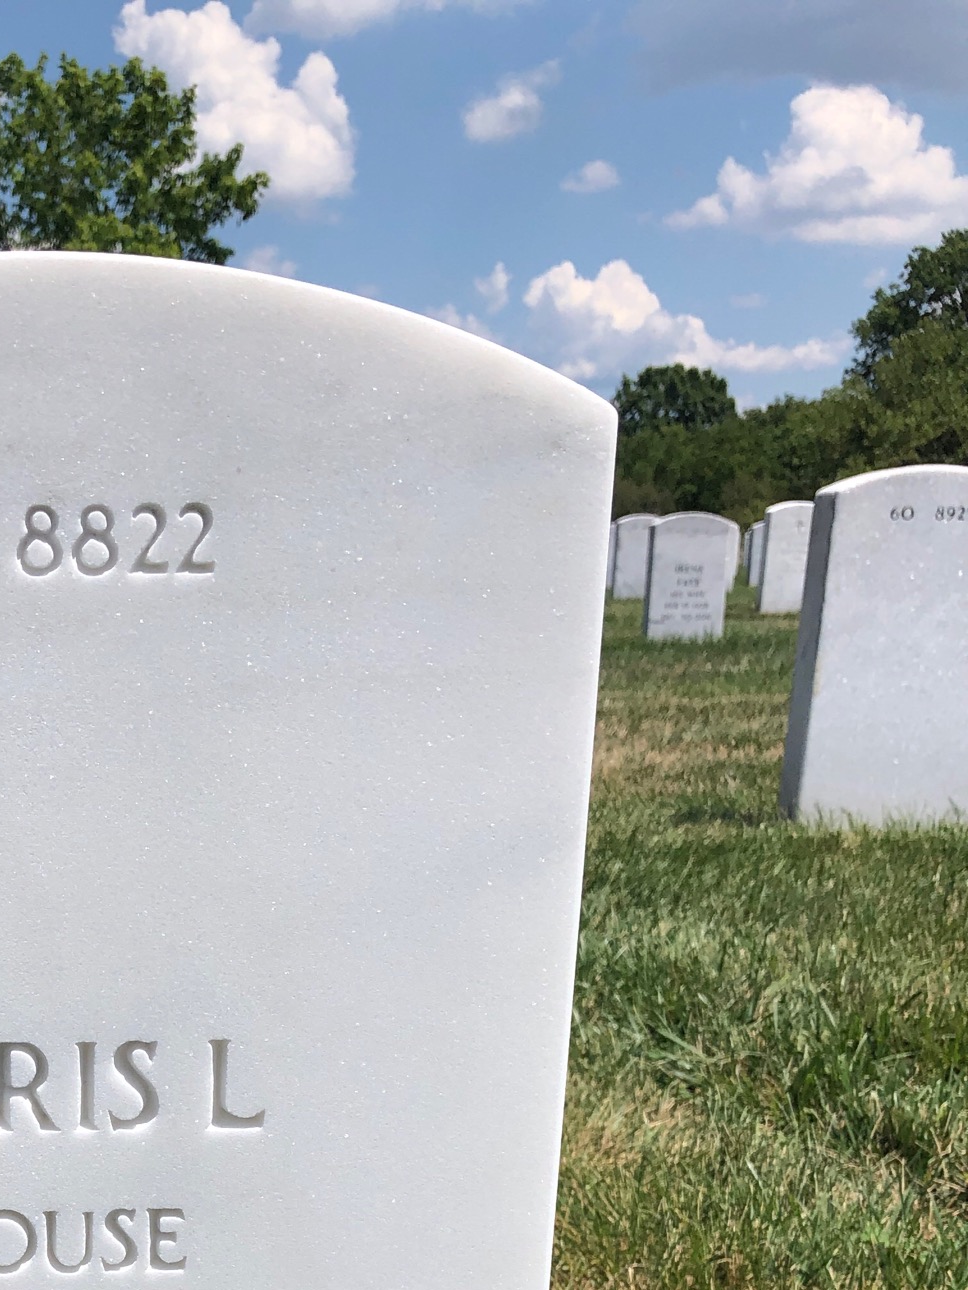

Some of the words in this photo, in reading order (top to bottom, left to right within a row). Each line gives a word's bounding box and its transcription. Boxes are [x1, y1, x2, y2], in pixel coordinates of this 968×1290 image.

[16, 501, 216, 577] 8822
[890, 505, 915, 521] 60
[935, 505, 968, 521] 892
[206, 1038, 266, 1132] L
